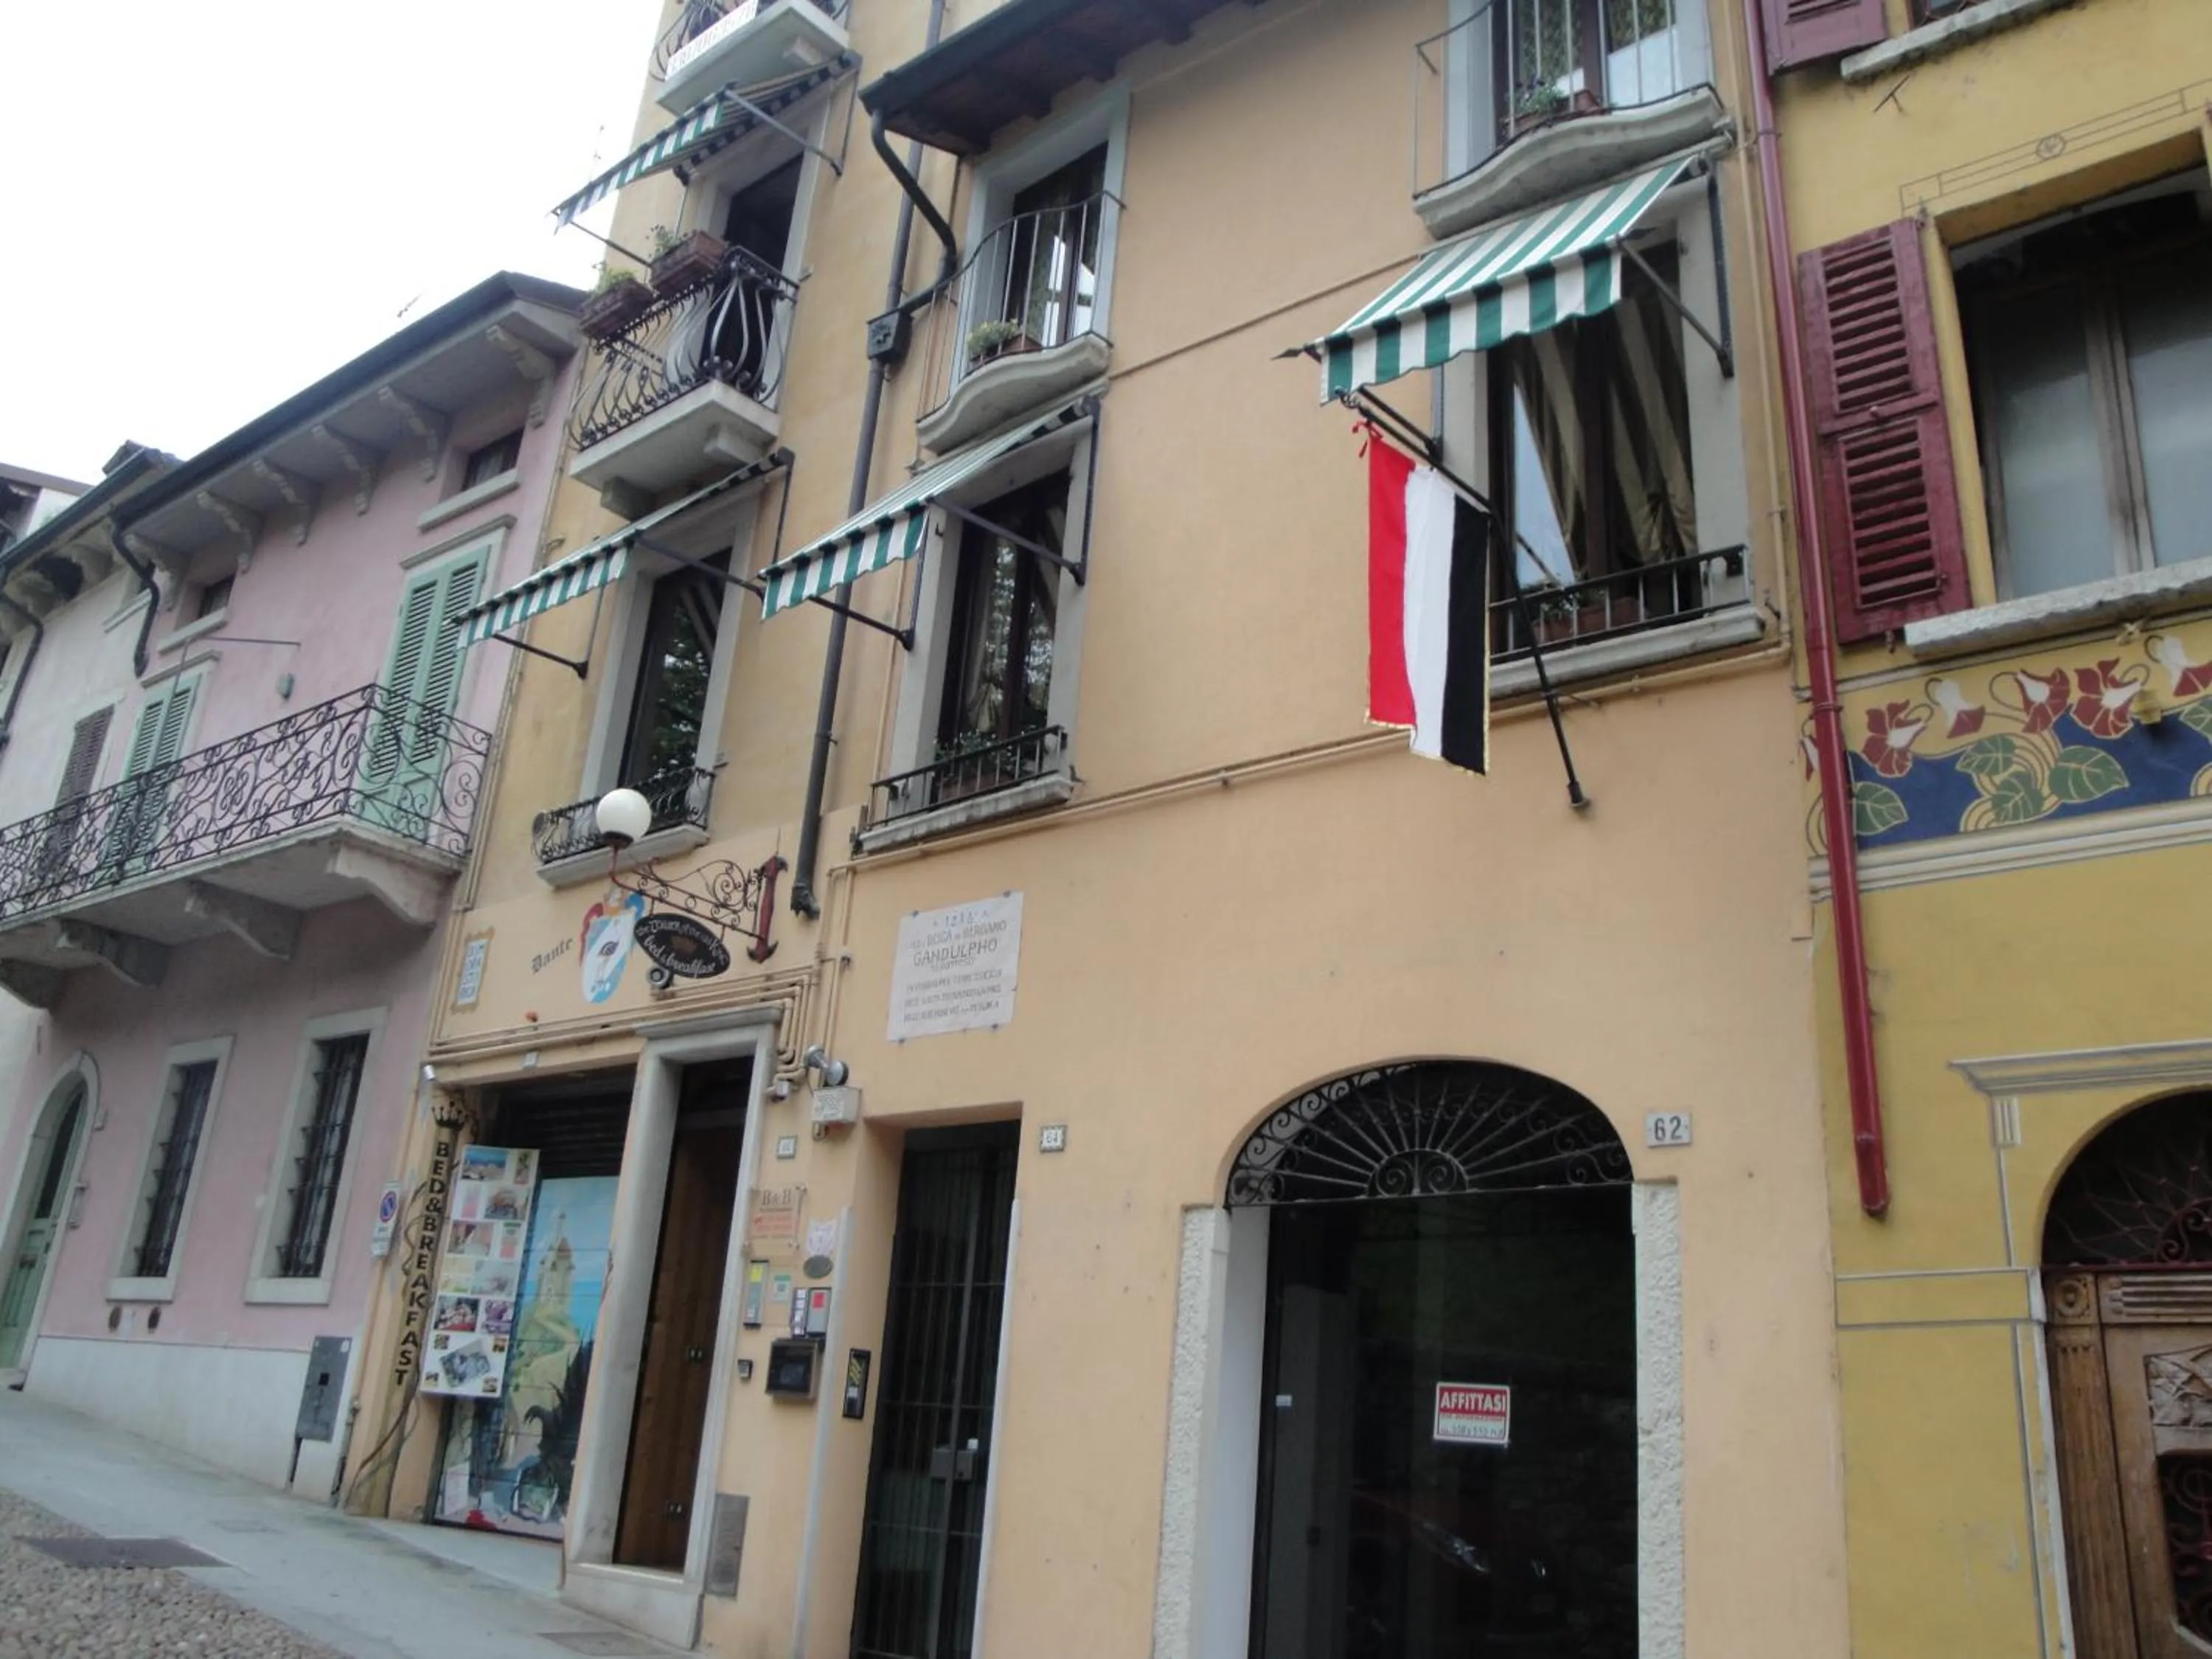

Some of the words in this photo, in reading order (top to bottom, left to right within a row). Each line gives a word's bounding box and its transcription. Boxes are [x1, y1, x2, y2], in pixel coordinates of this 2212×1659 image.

[913, 939, 998, 967] GANDULPHO
[1654, 1116, 1683, 1142] 62
[1440, 1391, 1506, 1413] AFFITTASI
